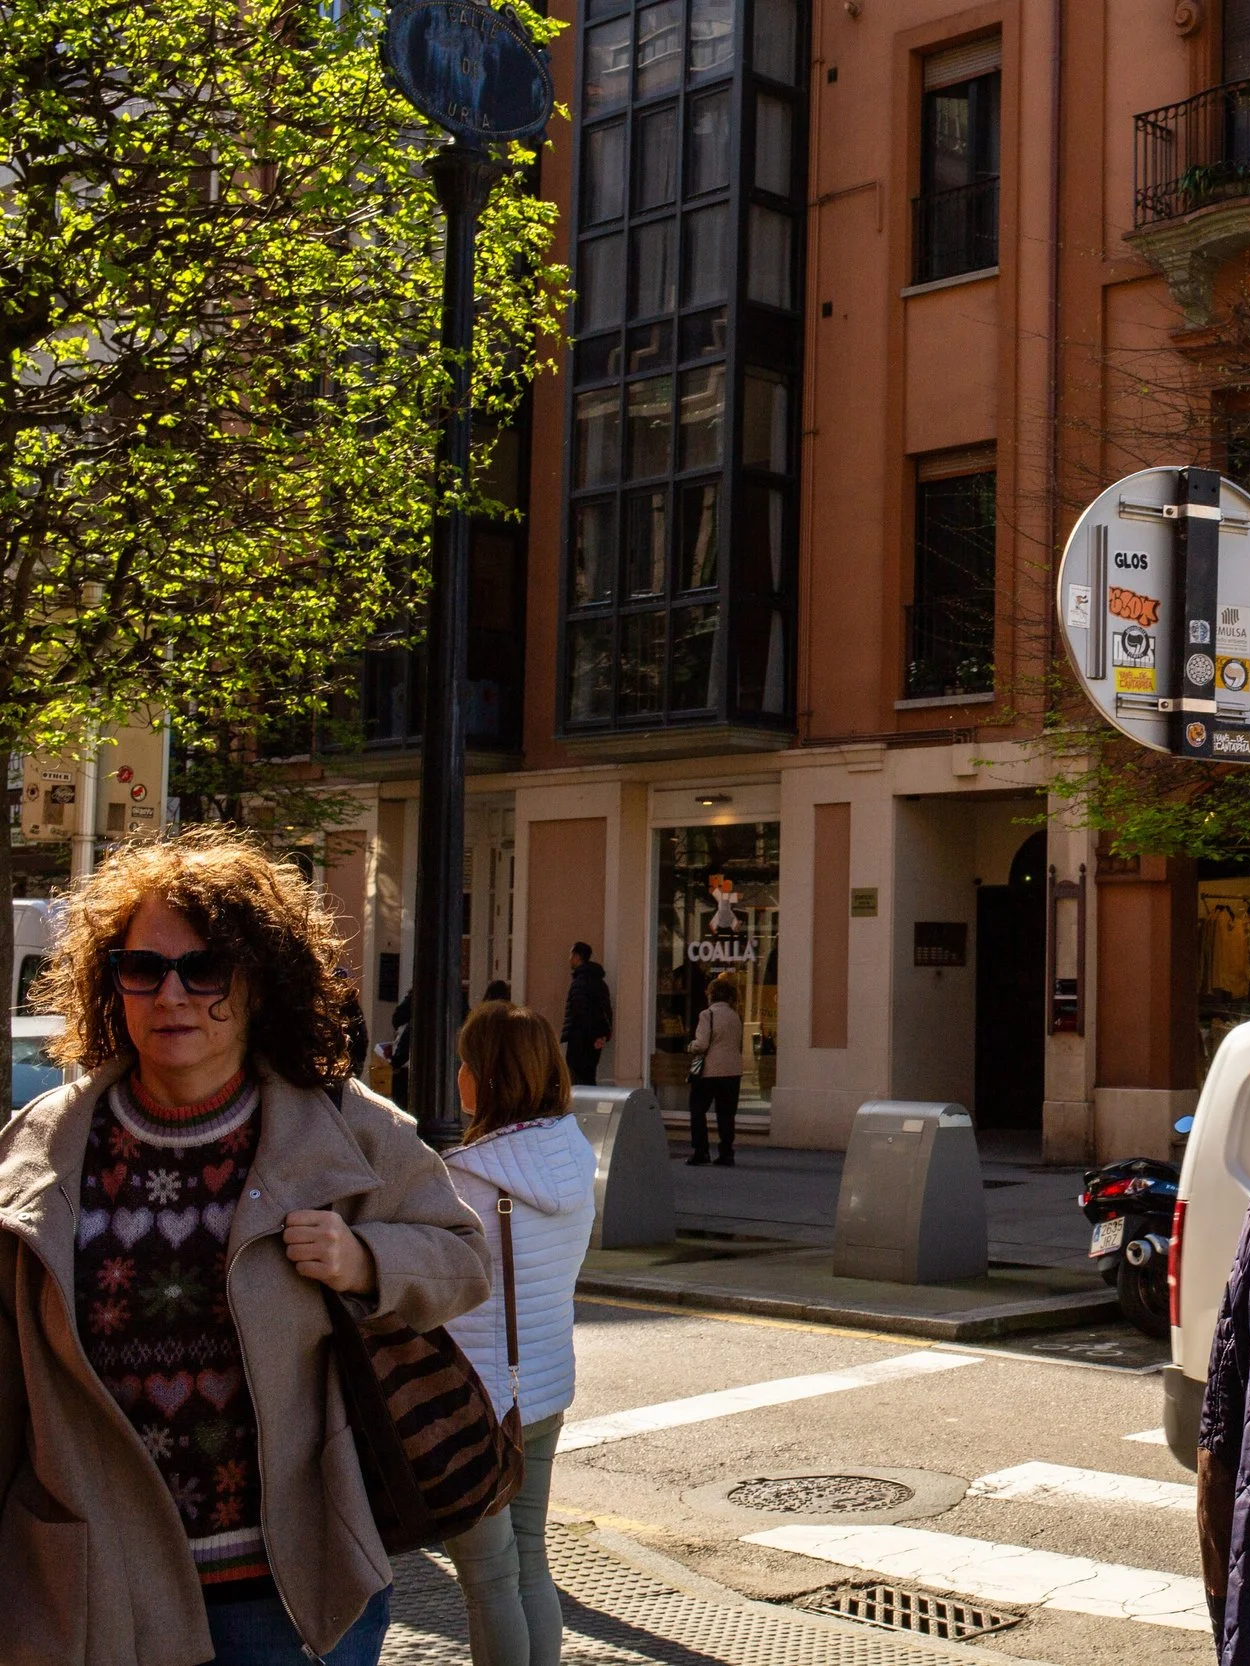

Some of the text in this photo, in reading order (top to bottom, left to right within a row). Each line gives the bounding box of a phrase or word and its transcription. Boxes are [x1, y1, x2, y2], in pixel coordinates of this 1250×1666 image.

[1114, 552, 1148, 570] GLOS
[1216, 626, 1248, 638] MULSA
[687, 940, 756, 962] COALLA
[1101, 1219, 1122, 1237] 2635
[1100, 1234, 1117, 1249] JRZ
